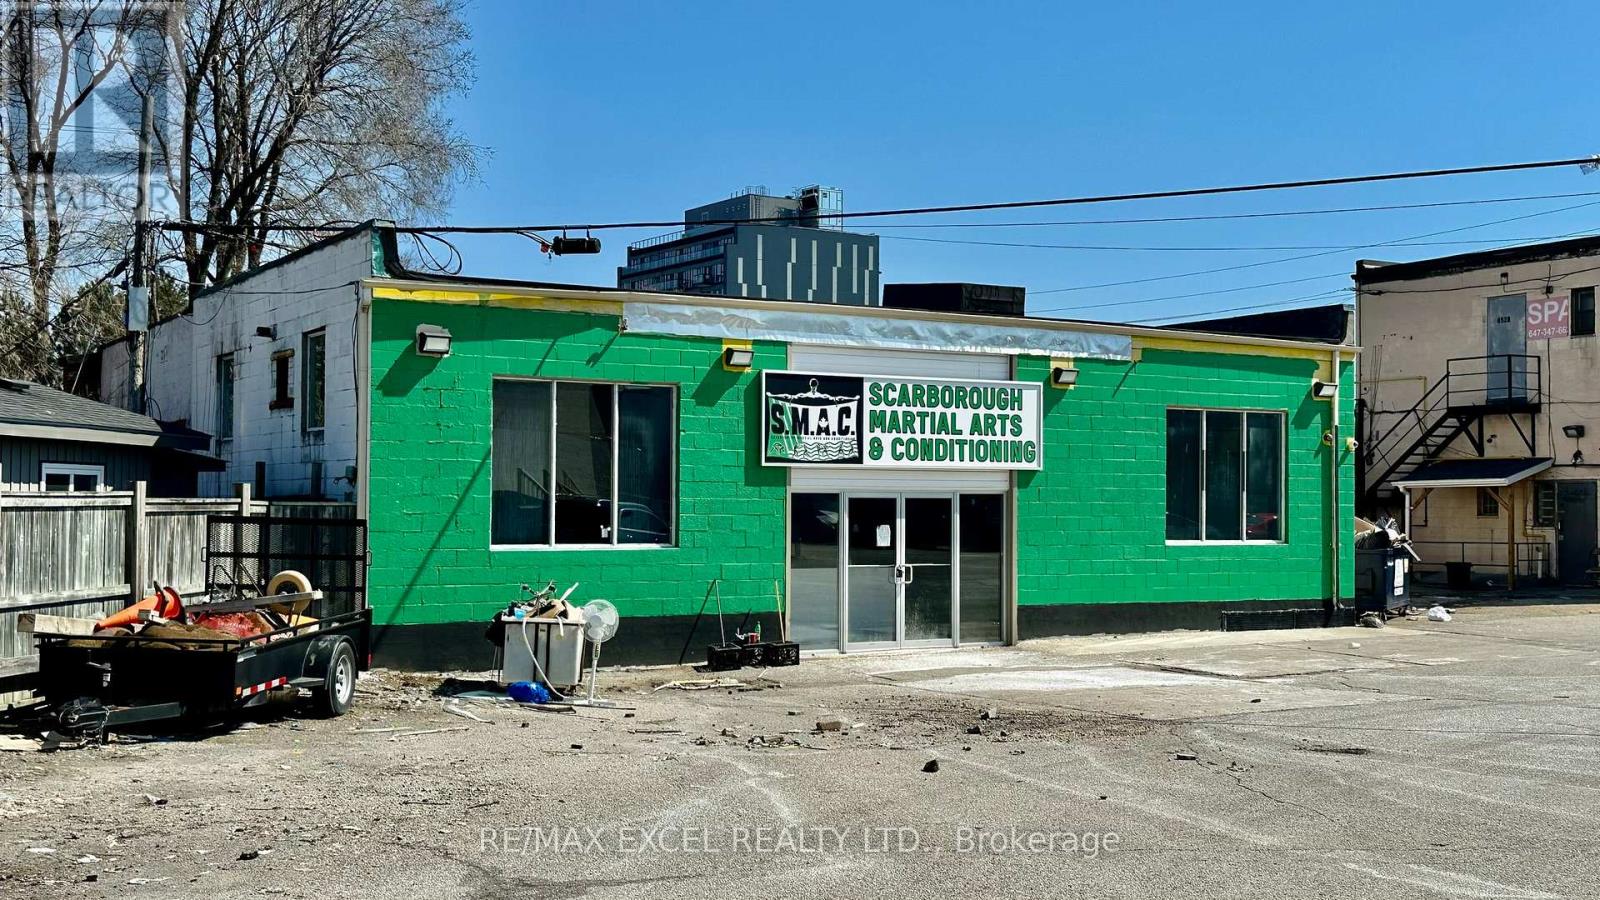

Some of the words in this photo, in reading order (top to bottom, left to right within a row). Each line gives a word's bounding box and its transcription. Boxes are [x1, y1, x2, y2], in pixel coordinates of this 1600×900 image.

[1528, 299, 1568, 325] SPA
[868, 382, 1023, 411] SCARBOROUGH
[868, 409, 964, 436] MARTIAL
[969, 412, 1023, 437] ARTS
[868, 436, 884, 461] &
[891, 437, 1036, 463] CONDITIONING
